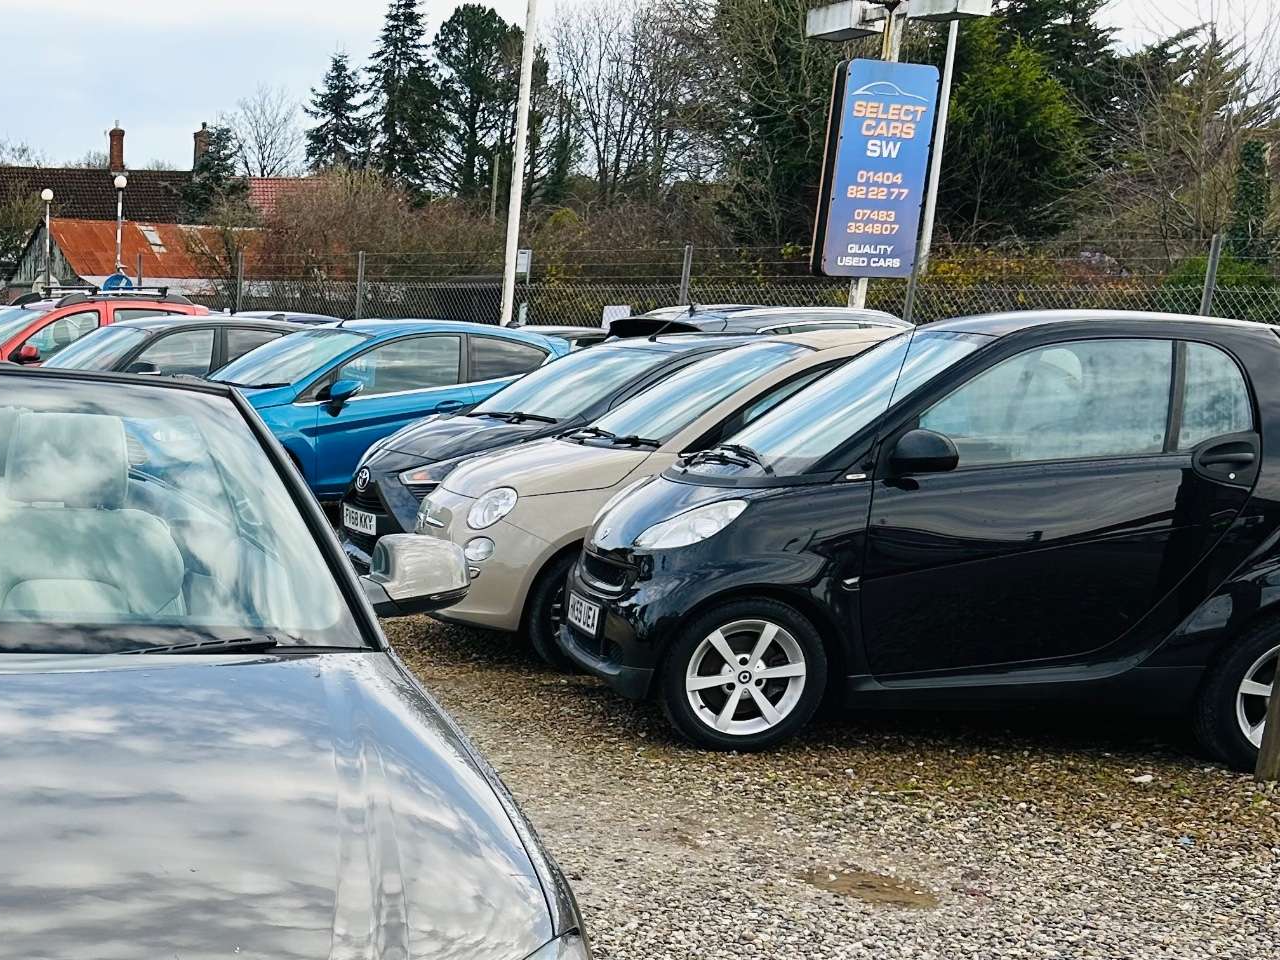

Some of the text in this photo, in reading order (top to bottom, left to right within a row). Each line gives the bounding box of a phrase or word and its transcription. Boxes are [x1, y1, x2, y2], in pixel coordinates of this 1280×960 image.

[852, 101, 928, 122] SELECT
[861, 119, 916, 139] CARS
[866, 139, 902, 159] SW
[857, 170, 903, 185] 01404
[854, 208, 896, 222] 07483
[846, 222, 900, 235] 334807
[847, 243, 895, 255] QUALITY
[837, 256, 901, 268] USED CARS
